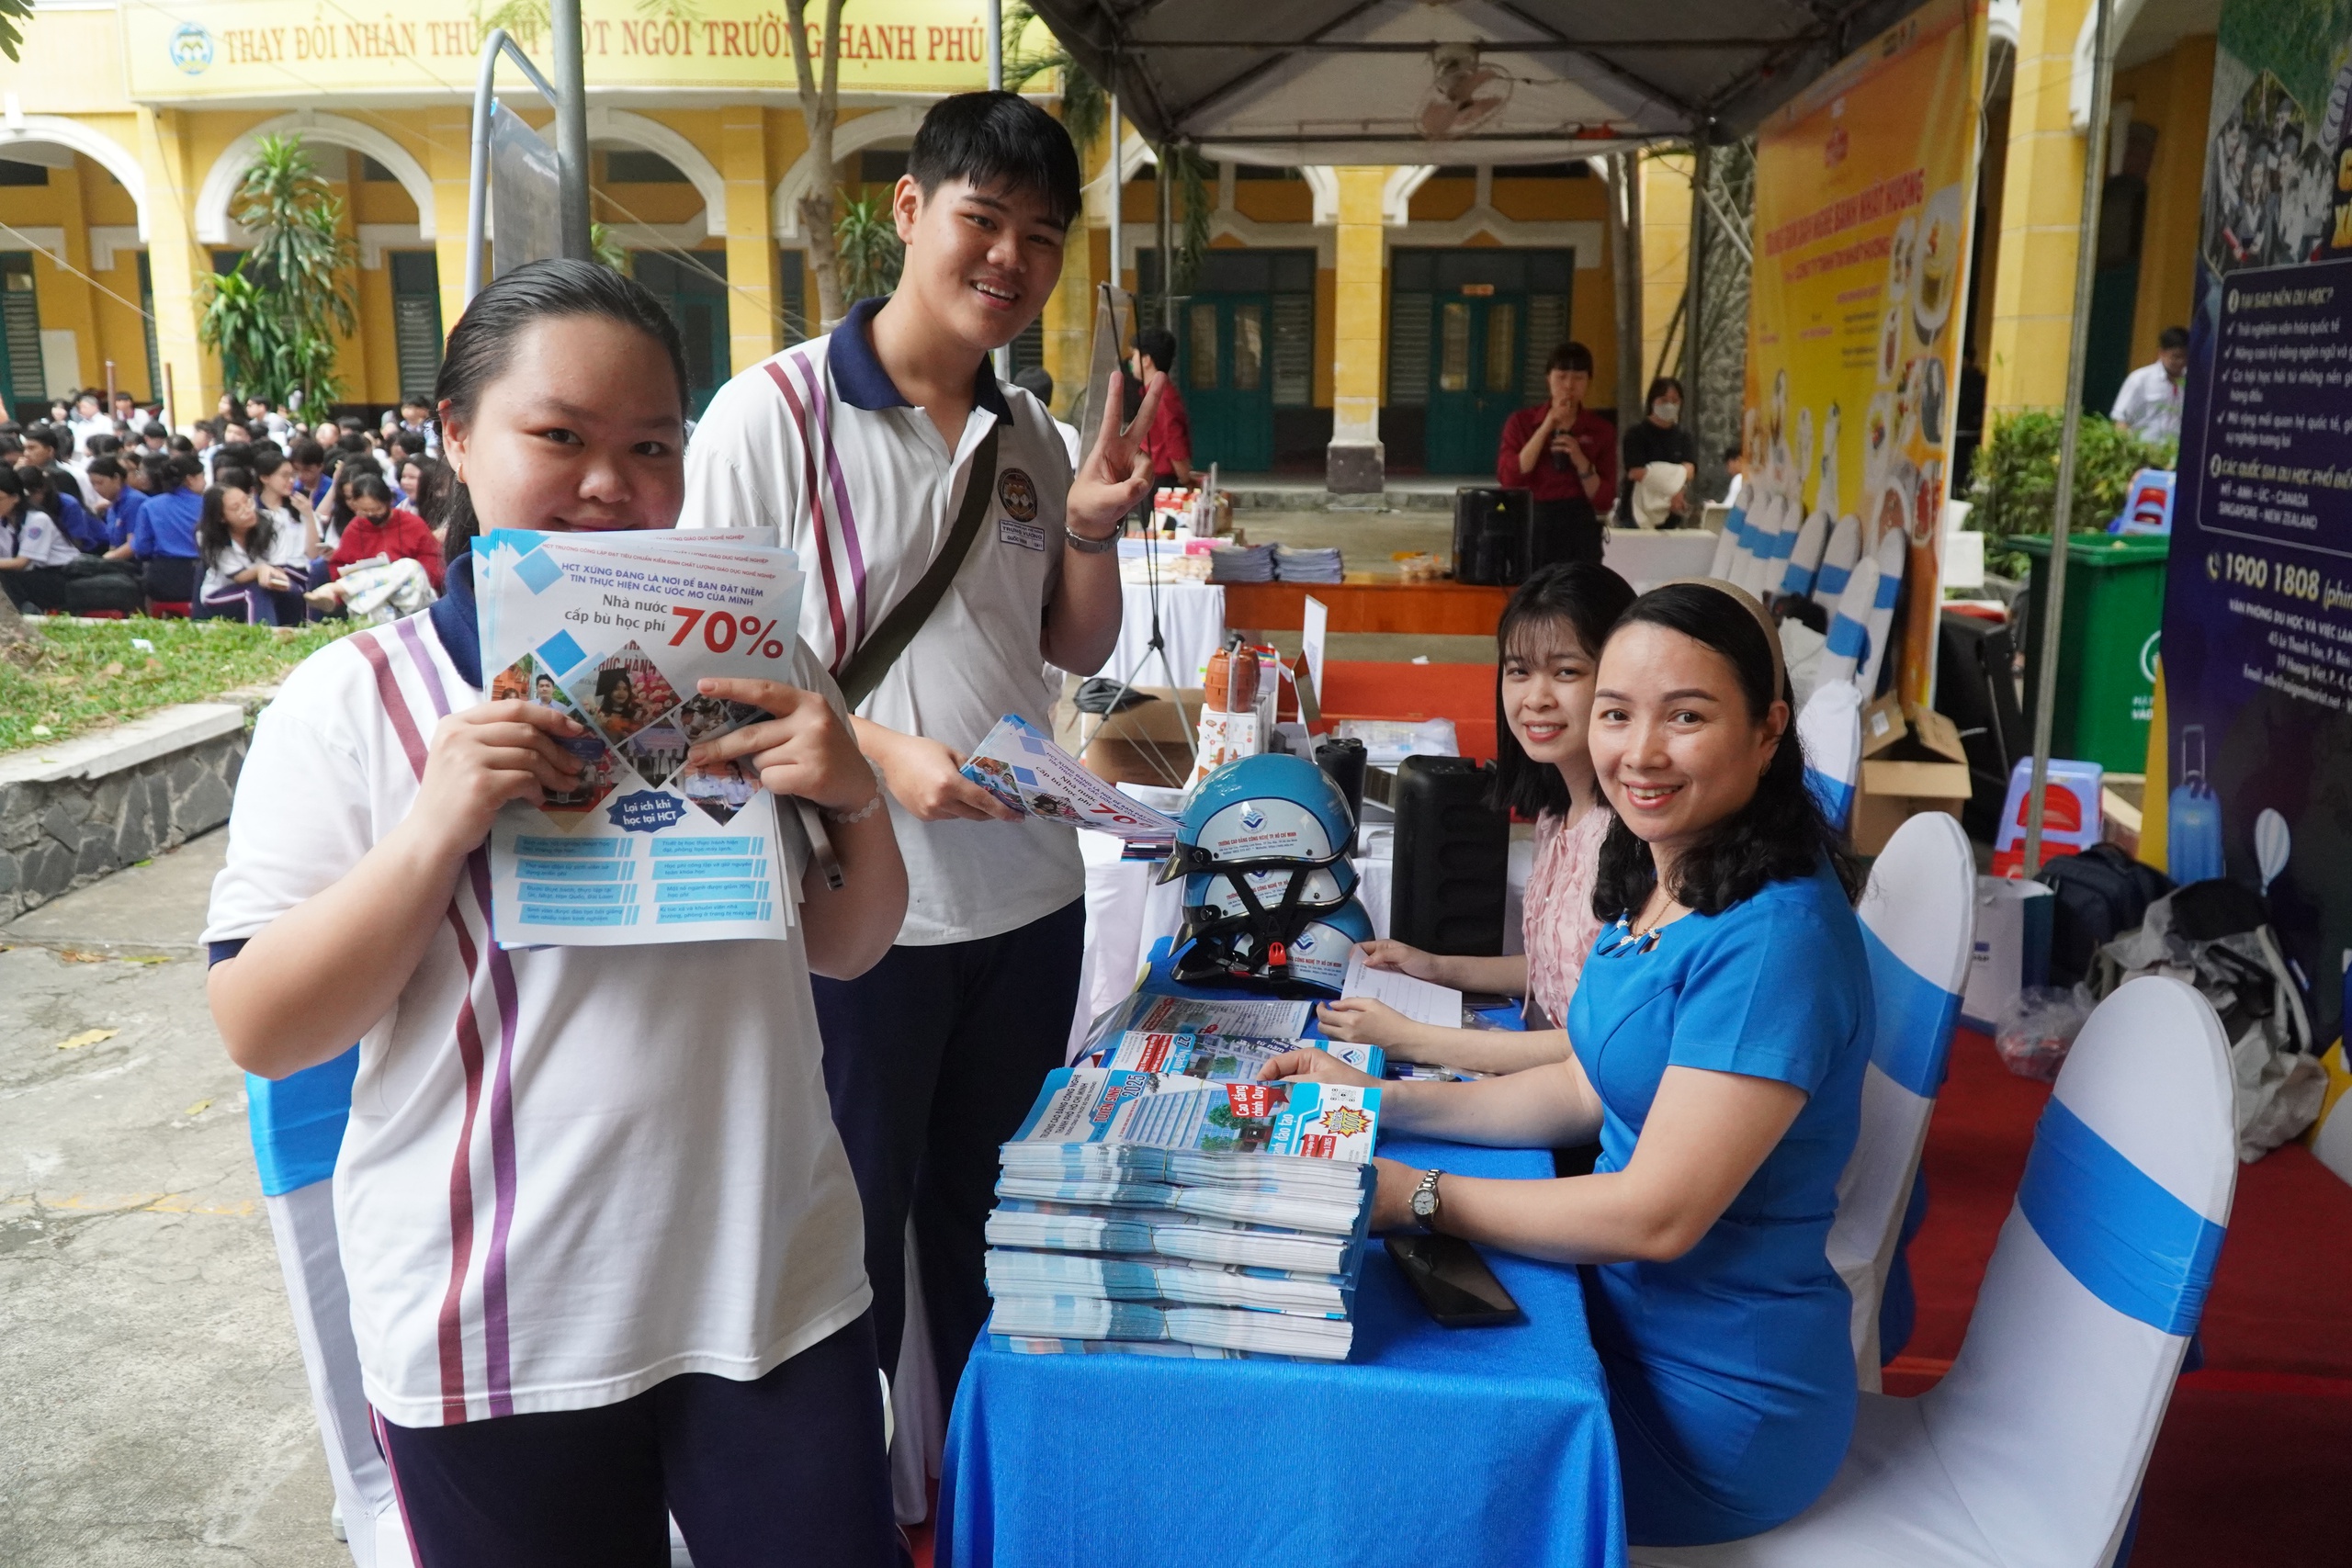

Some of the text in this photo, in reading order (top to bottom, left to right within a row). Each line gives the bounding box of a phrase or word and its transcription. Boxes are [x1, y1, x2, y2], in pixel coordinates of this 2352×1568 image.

[224, 25, 286, 63] THAY
[295, 16, 339, 60] ĐỔI
[345, 12, 416, 66] NHẬN
[427, 11, 481, 56] THỨ
[621, 12, 693, 56] NGÔI
[926, 17, 989, 62] PHÚ
[2276, 490, 2309, 508] CANADA
[2282, 511, 2318, 530] ZEALAND
[580, 547, 595, 555] CÔNG
[561, 563, 764, 598] HCT XỨNG ĐÁNG LÀ NƠI ĐỂ BẠN ĐẶT NIỀM
[570, 574, 587, 584] TIN
[589, 577, 615, 589] THỰC
[617, 581, 640, 592] HIỆN
[642, 583, 662, 594] CÁC
[687, 591, 705, 599] MƠ
[707, 591, 727, 603] CỦA
[729, 594, 754, 606] MÌNH
[2226, 552, 2268, 589] 1900
[2274, 562, 2321, 602] 1808
[602, 593, 668, 615] Nhà nước
[564, 607, 667, 634] cấp bù học phí
[668, 605, 785, 660] 70%
[1046, 752, 1057, 761] HCT
[1048, 759, 1057, 767] TIN
[1035, 766, 1050, 778] cấp
[1051, 777, 1061, 786] bù
[1062, 785, 1078, 798] học
[1078, 797, 1092, 807] phí
[1060, 775, 1077, 789] Nhà
[1078, 788, 1098, 804] nước
[623, 810, 677, 826] học tại HCT
[624, 802, 639, 814] Lợi
[655, 799, 672, 809] khi
[1172, 1035, 1193, 1069] 27 Ngành
[1267, 1043, 1284, 1054] năm
[1050, 1114, 1061, 1123] CAO
[1062, 1088, 1075, 1101] CÔNG
[1069, 1074, 1081, 1088] NGHỆ
[1077, 1083, 1089, 1095] MINH
[1093, 1102, 1115, 1122] TUYỂN
[1104, 1086, 1122, 1101] SINH
[1122, 1075, 1147, 1098] 2025
[1231, 1085, 1250, 1116] Cao đẳng
[1251, 1086, 1266, 1117] chính Quy
[1279, 1113, 1296, 1126] tạo
[1273, 1127, 1291, 1142] đào
